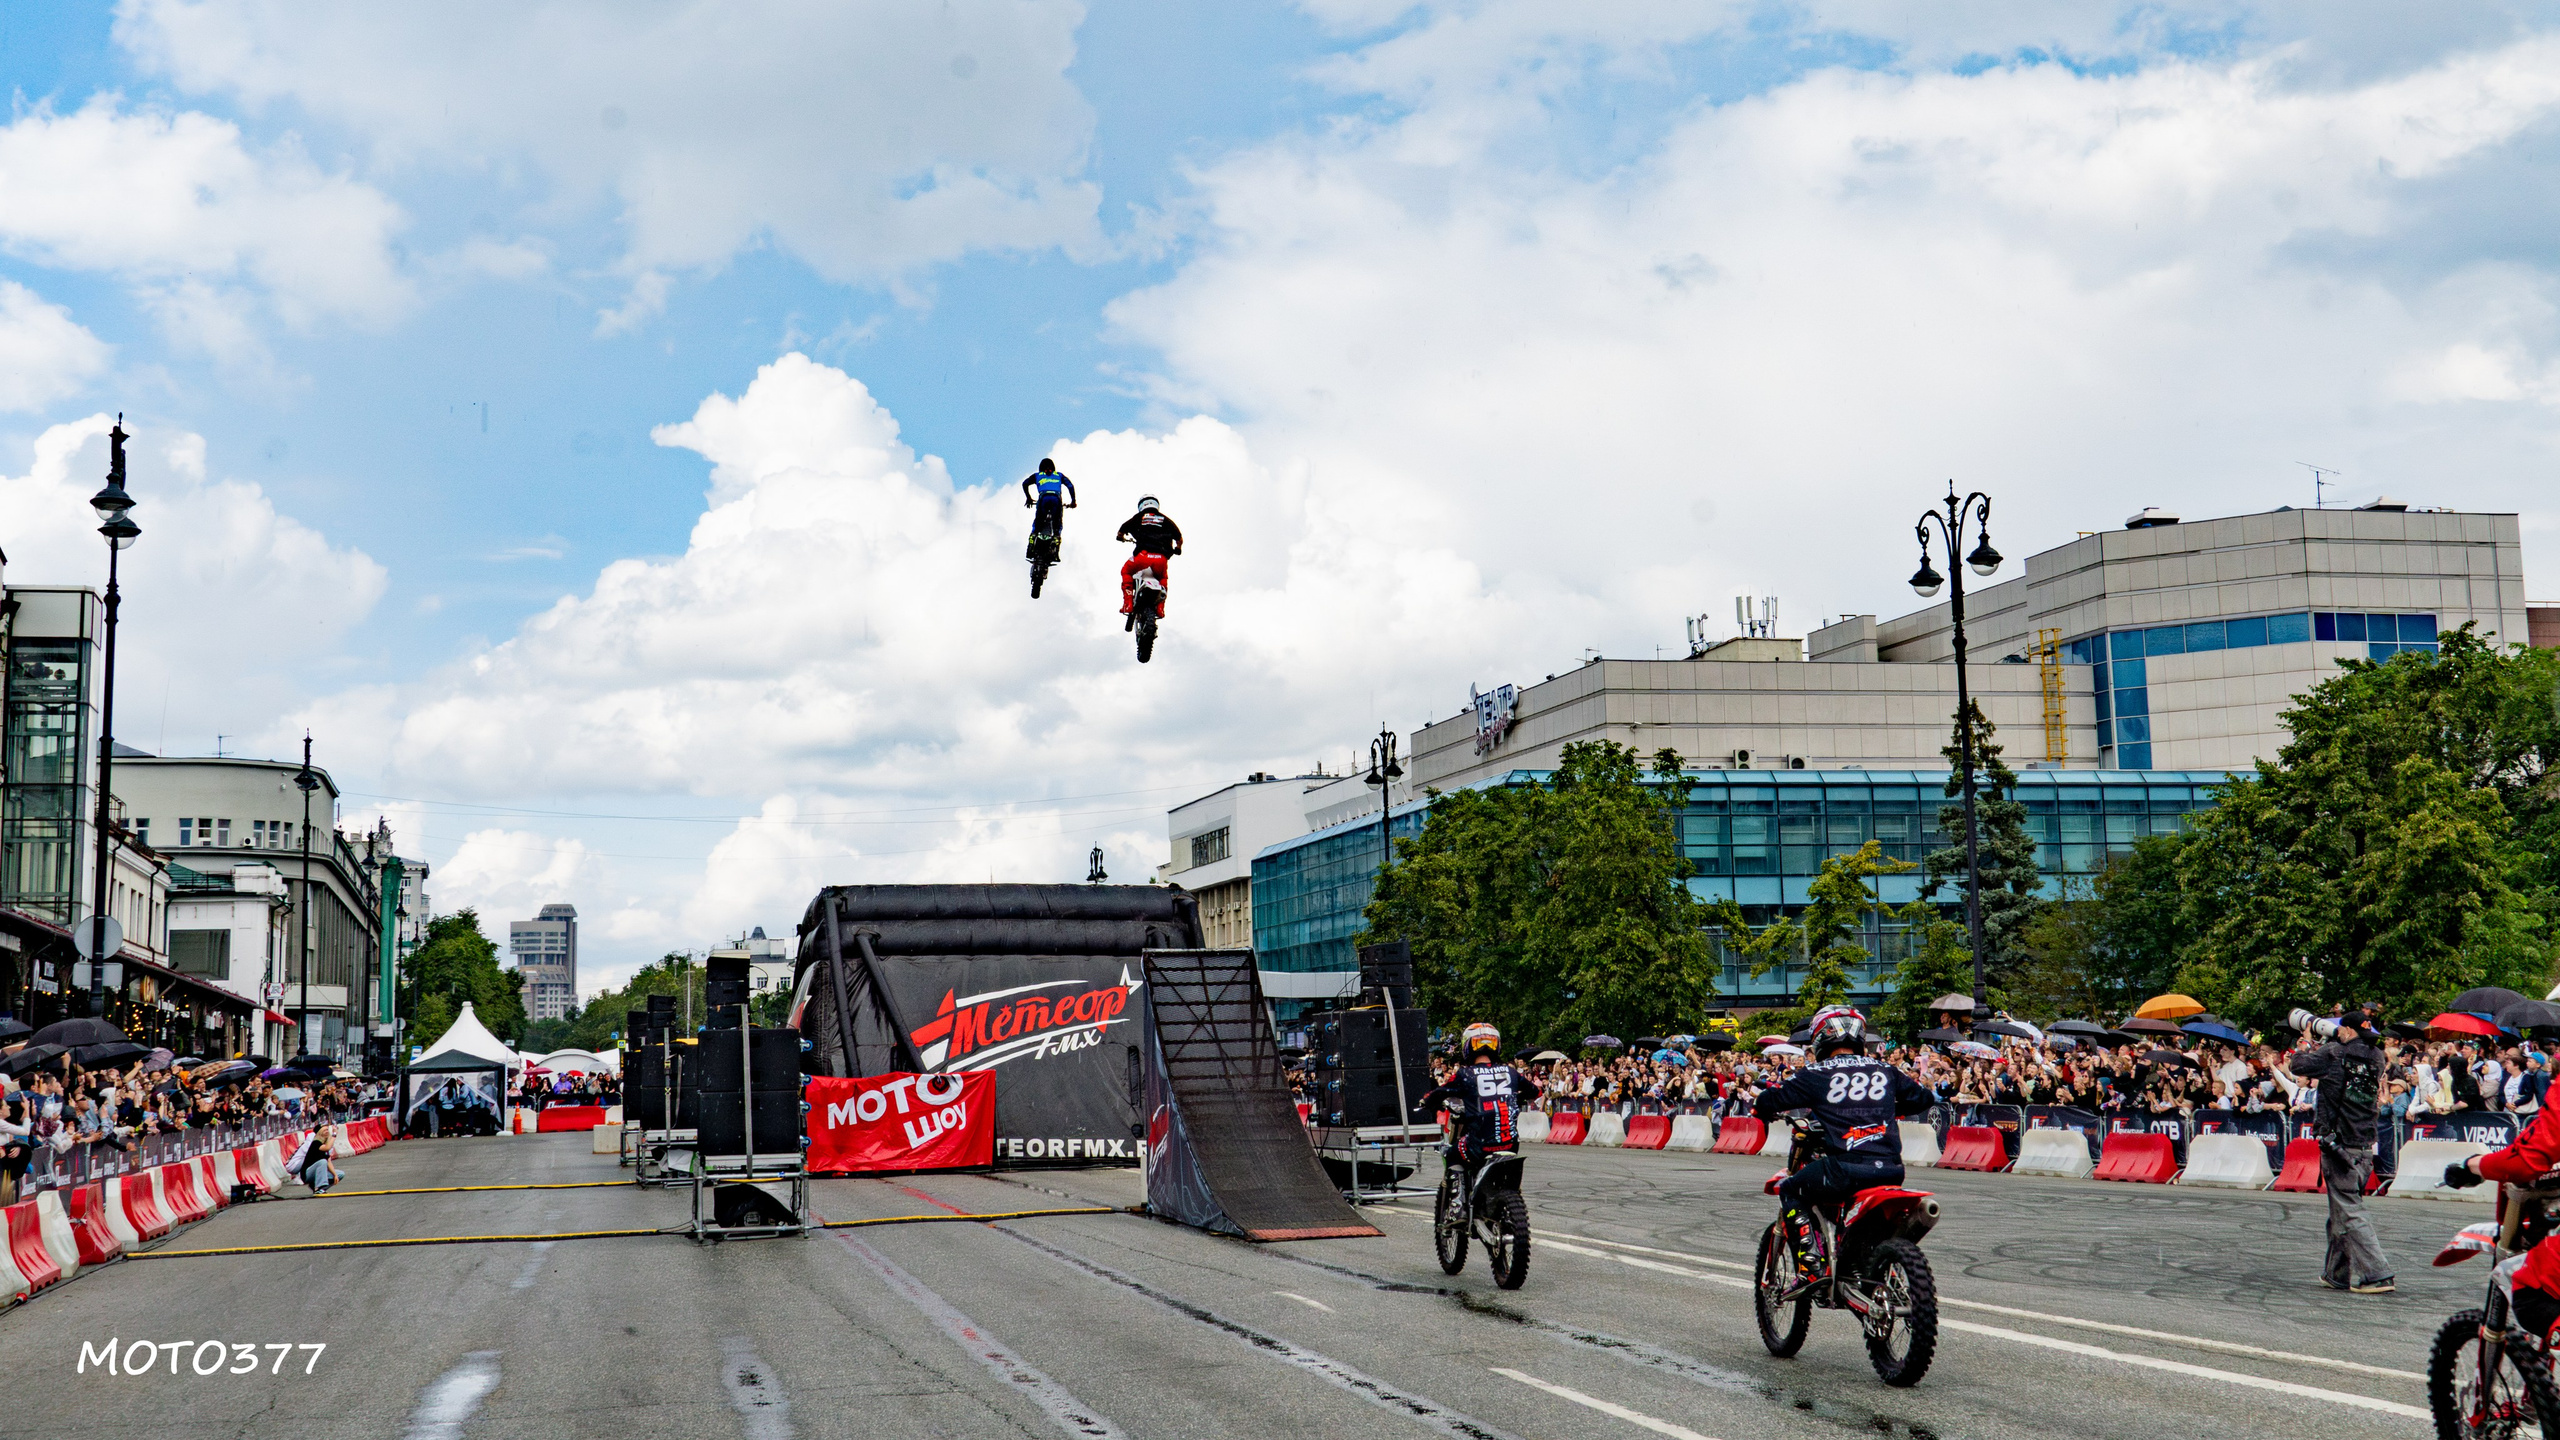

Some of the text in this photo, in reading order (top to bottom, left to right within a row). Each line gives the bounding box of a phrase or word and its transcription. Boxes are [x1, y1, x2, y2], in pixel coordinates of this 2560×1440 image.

[1476, 684, 1516, 731] ТЕАТР
[1477, 1072, 1512, 1097] 62
[1826, 1071, 1888, 1104] 888
[827, 1074, 964, 1130] МОТО
[2463, 1125, 2509, 1145] VIRAX
